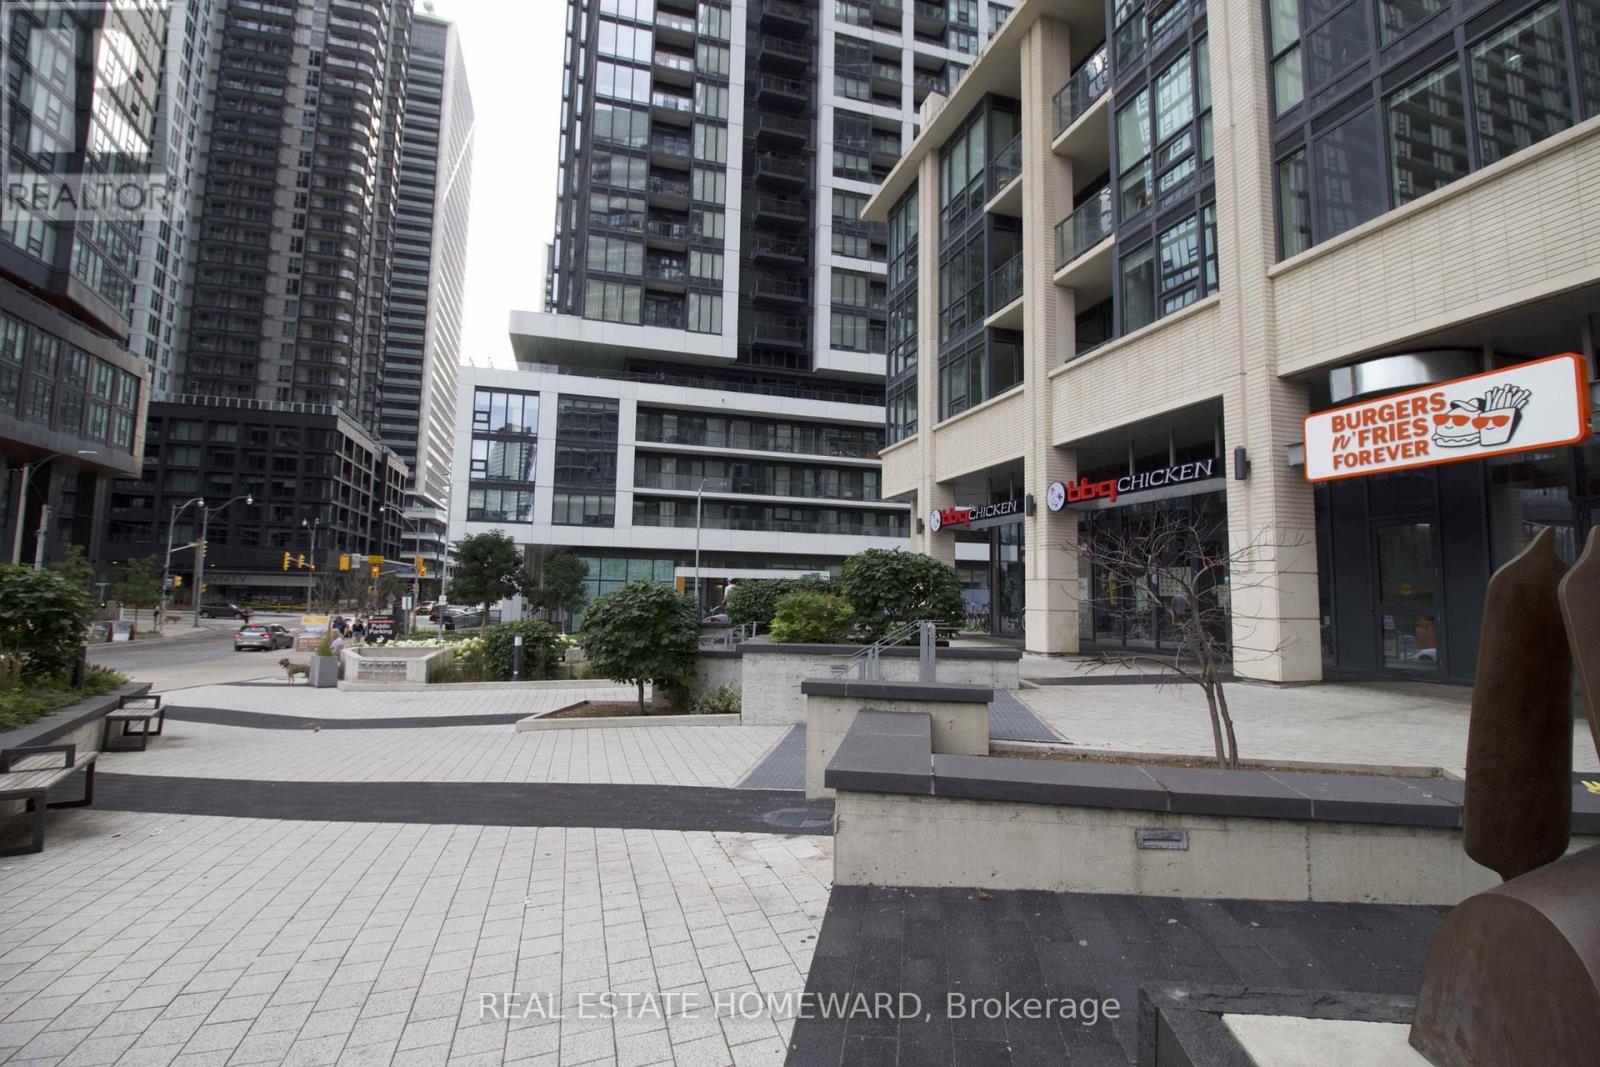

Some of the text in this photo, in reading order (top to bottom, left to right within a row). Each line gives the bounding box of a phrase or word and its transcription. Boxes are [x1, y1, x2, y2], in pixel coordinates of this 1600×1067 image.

[1331, 392, 1446, 433] BURGERS
[1333, 440, 1430, 470] FOREVER
[1117, 459, 1213, 493] CHICKEN
[968, 500, 1017, 520] CHICKEN
